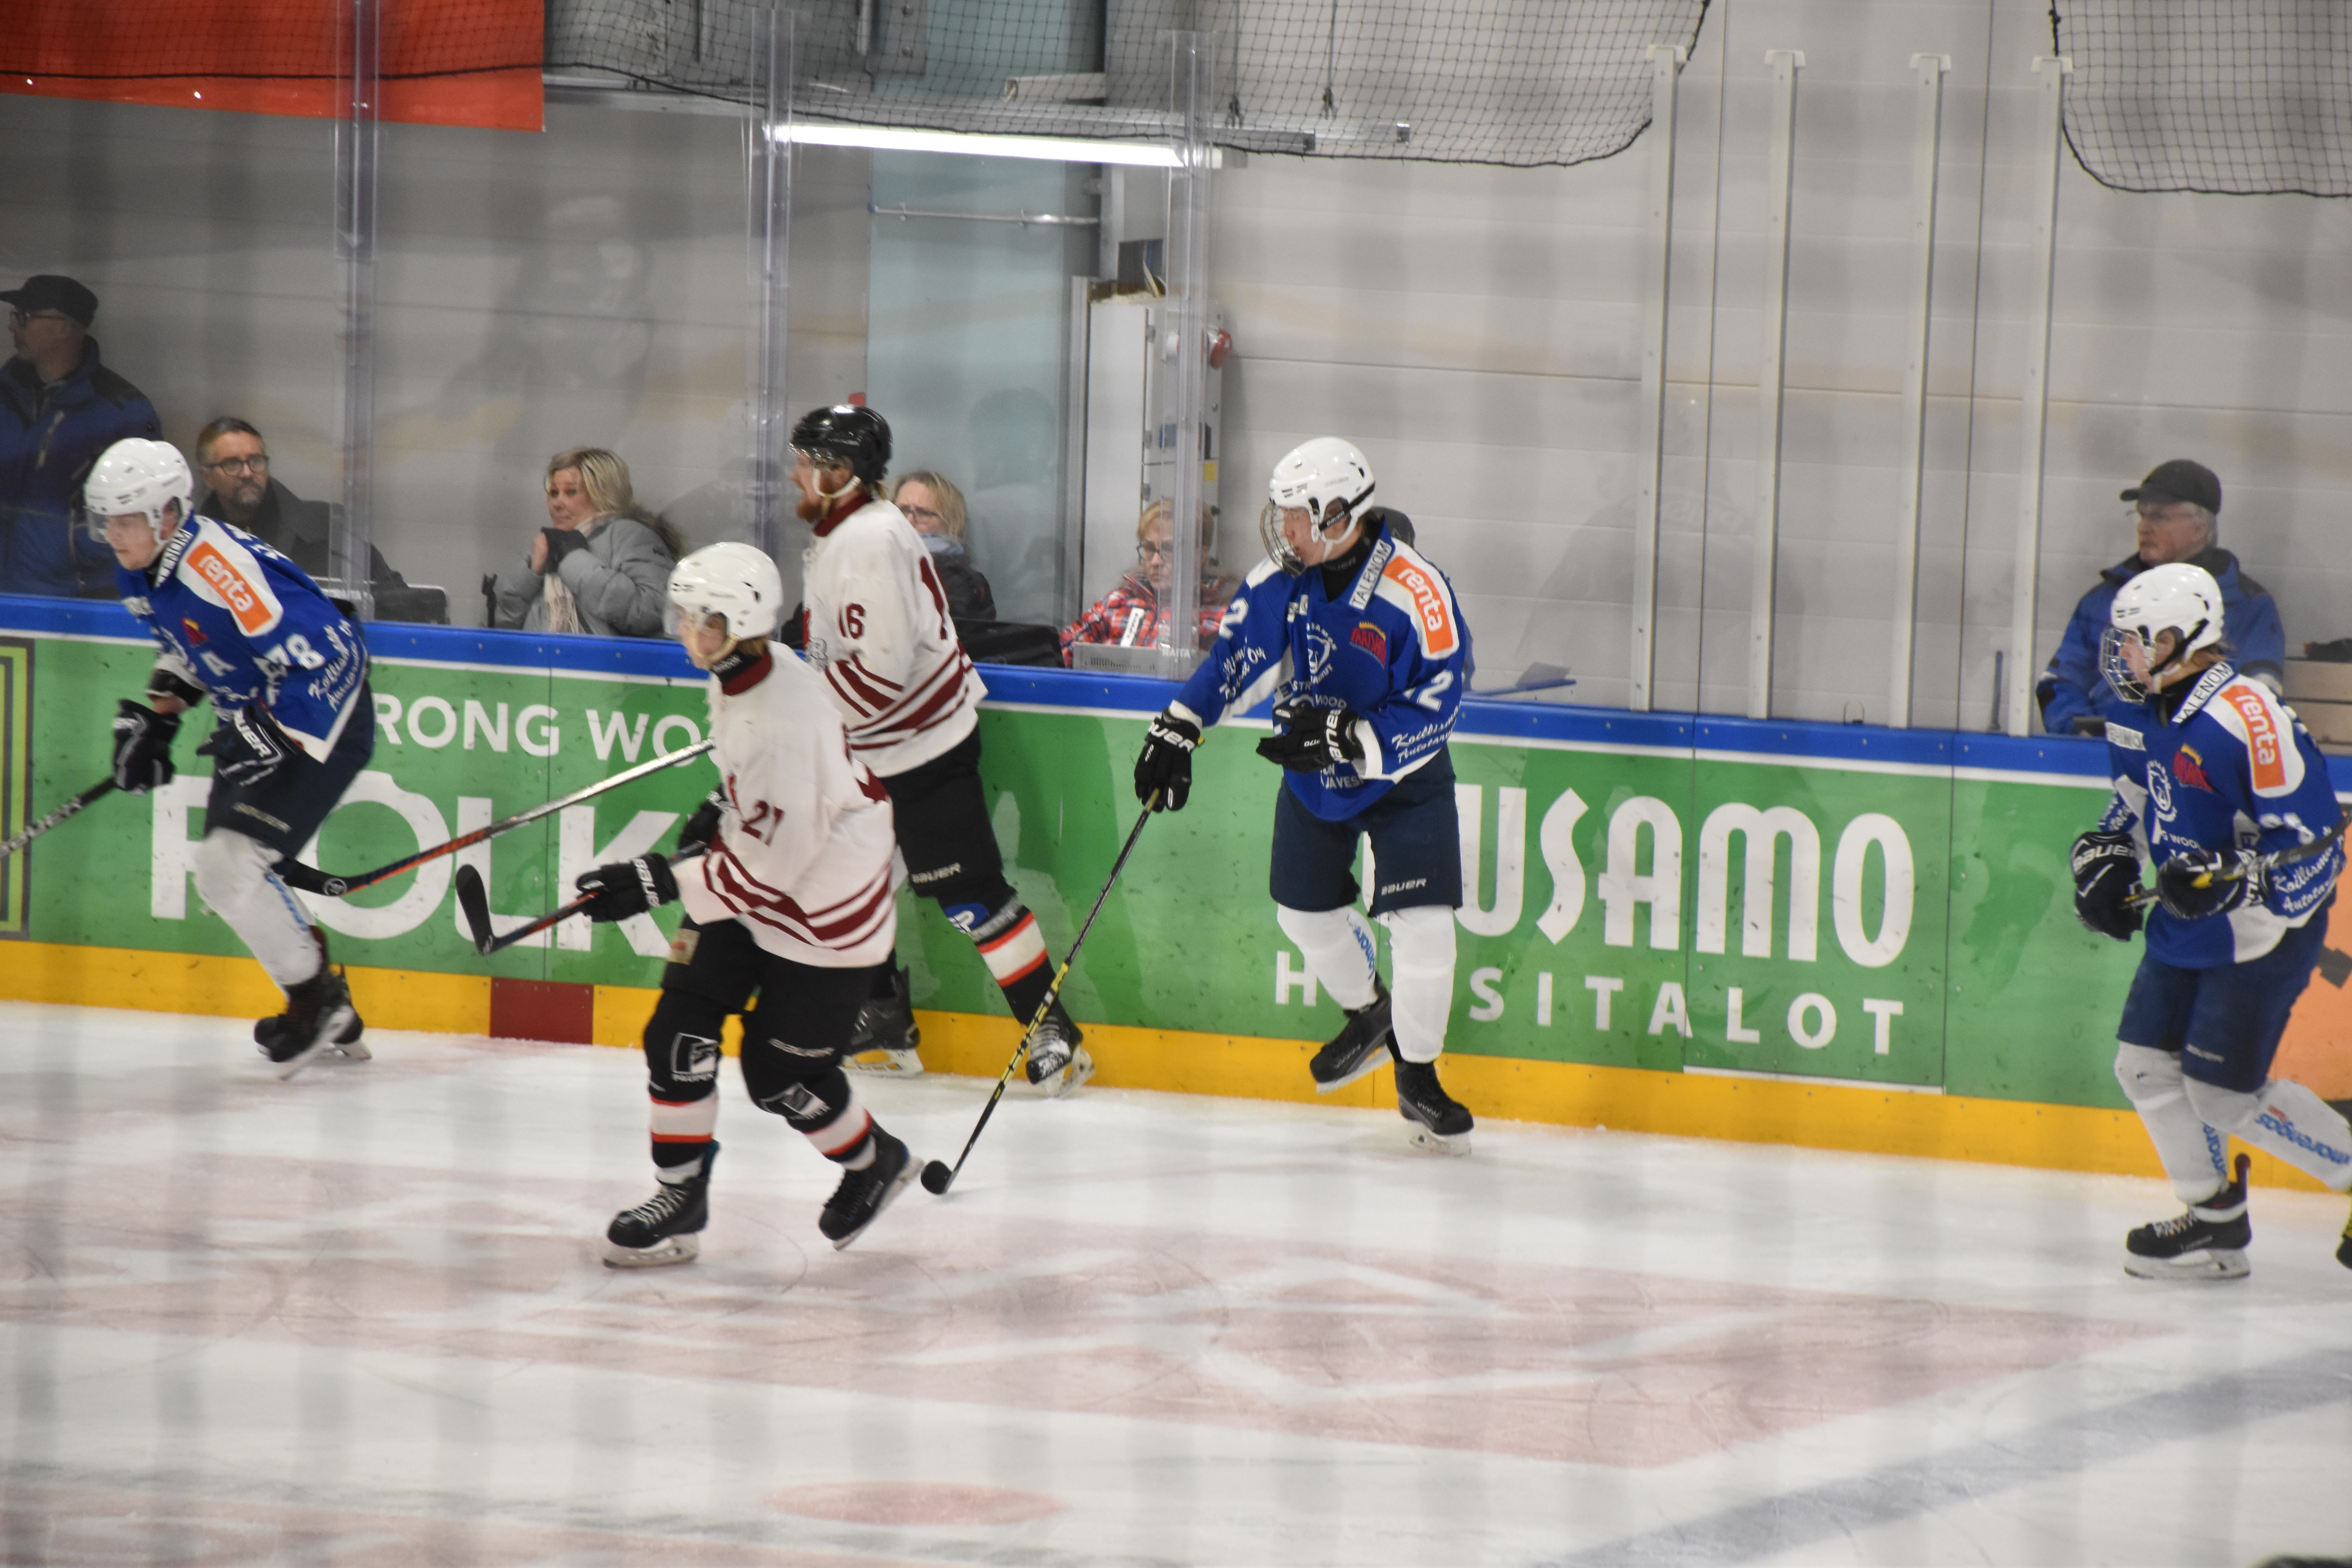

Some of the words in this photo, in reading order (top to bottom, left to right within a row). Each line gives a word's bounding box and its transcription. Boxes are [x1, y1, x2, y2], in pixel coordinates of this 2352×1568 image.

[198, 555, 254, 612] renta
[1351, 540, 1390, 608] TALENOM
[1397, 568, 1442, 632] renta
[838, 602, 866, 640] 16
[200, 651, 238, 677] A
[1403, 669, 1454, 713] 2
[374, 693, 559, 757] RONG
[586, 709, 706, 767] WO
[1148, 721, 1195, 753] UER
[2236, 695, 2276, 765] renta
[1455, 783, 1915, 967] USAMO
[1275, 951, 1904, 1055] HSITALOT
